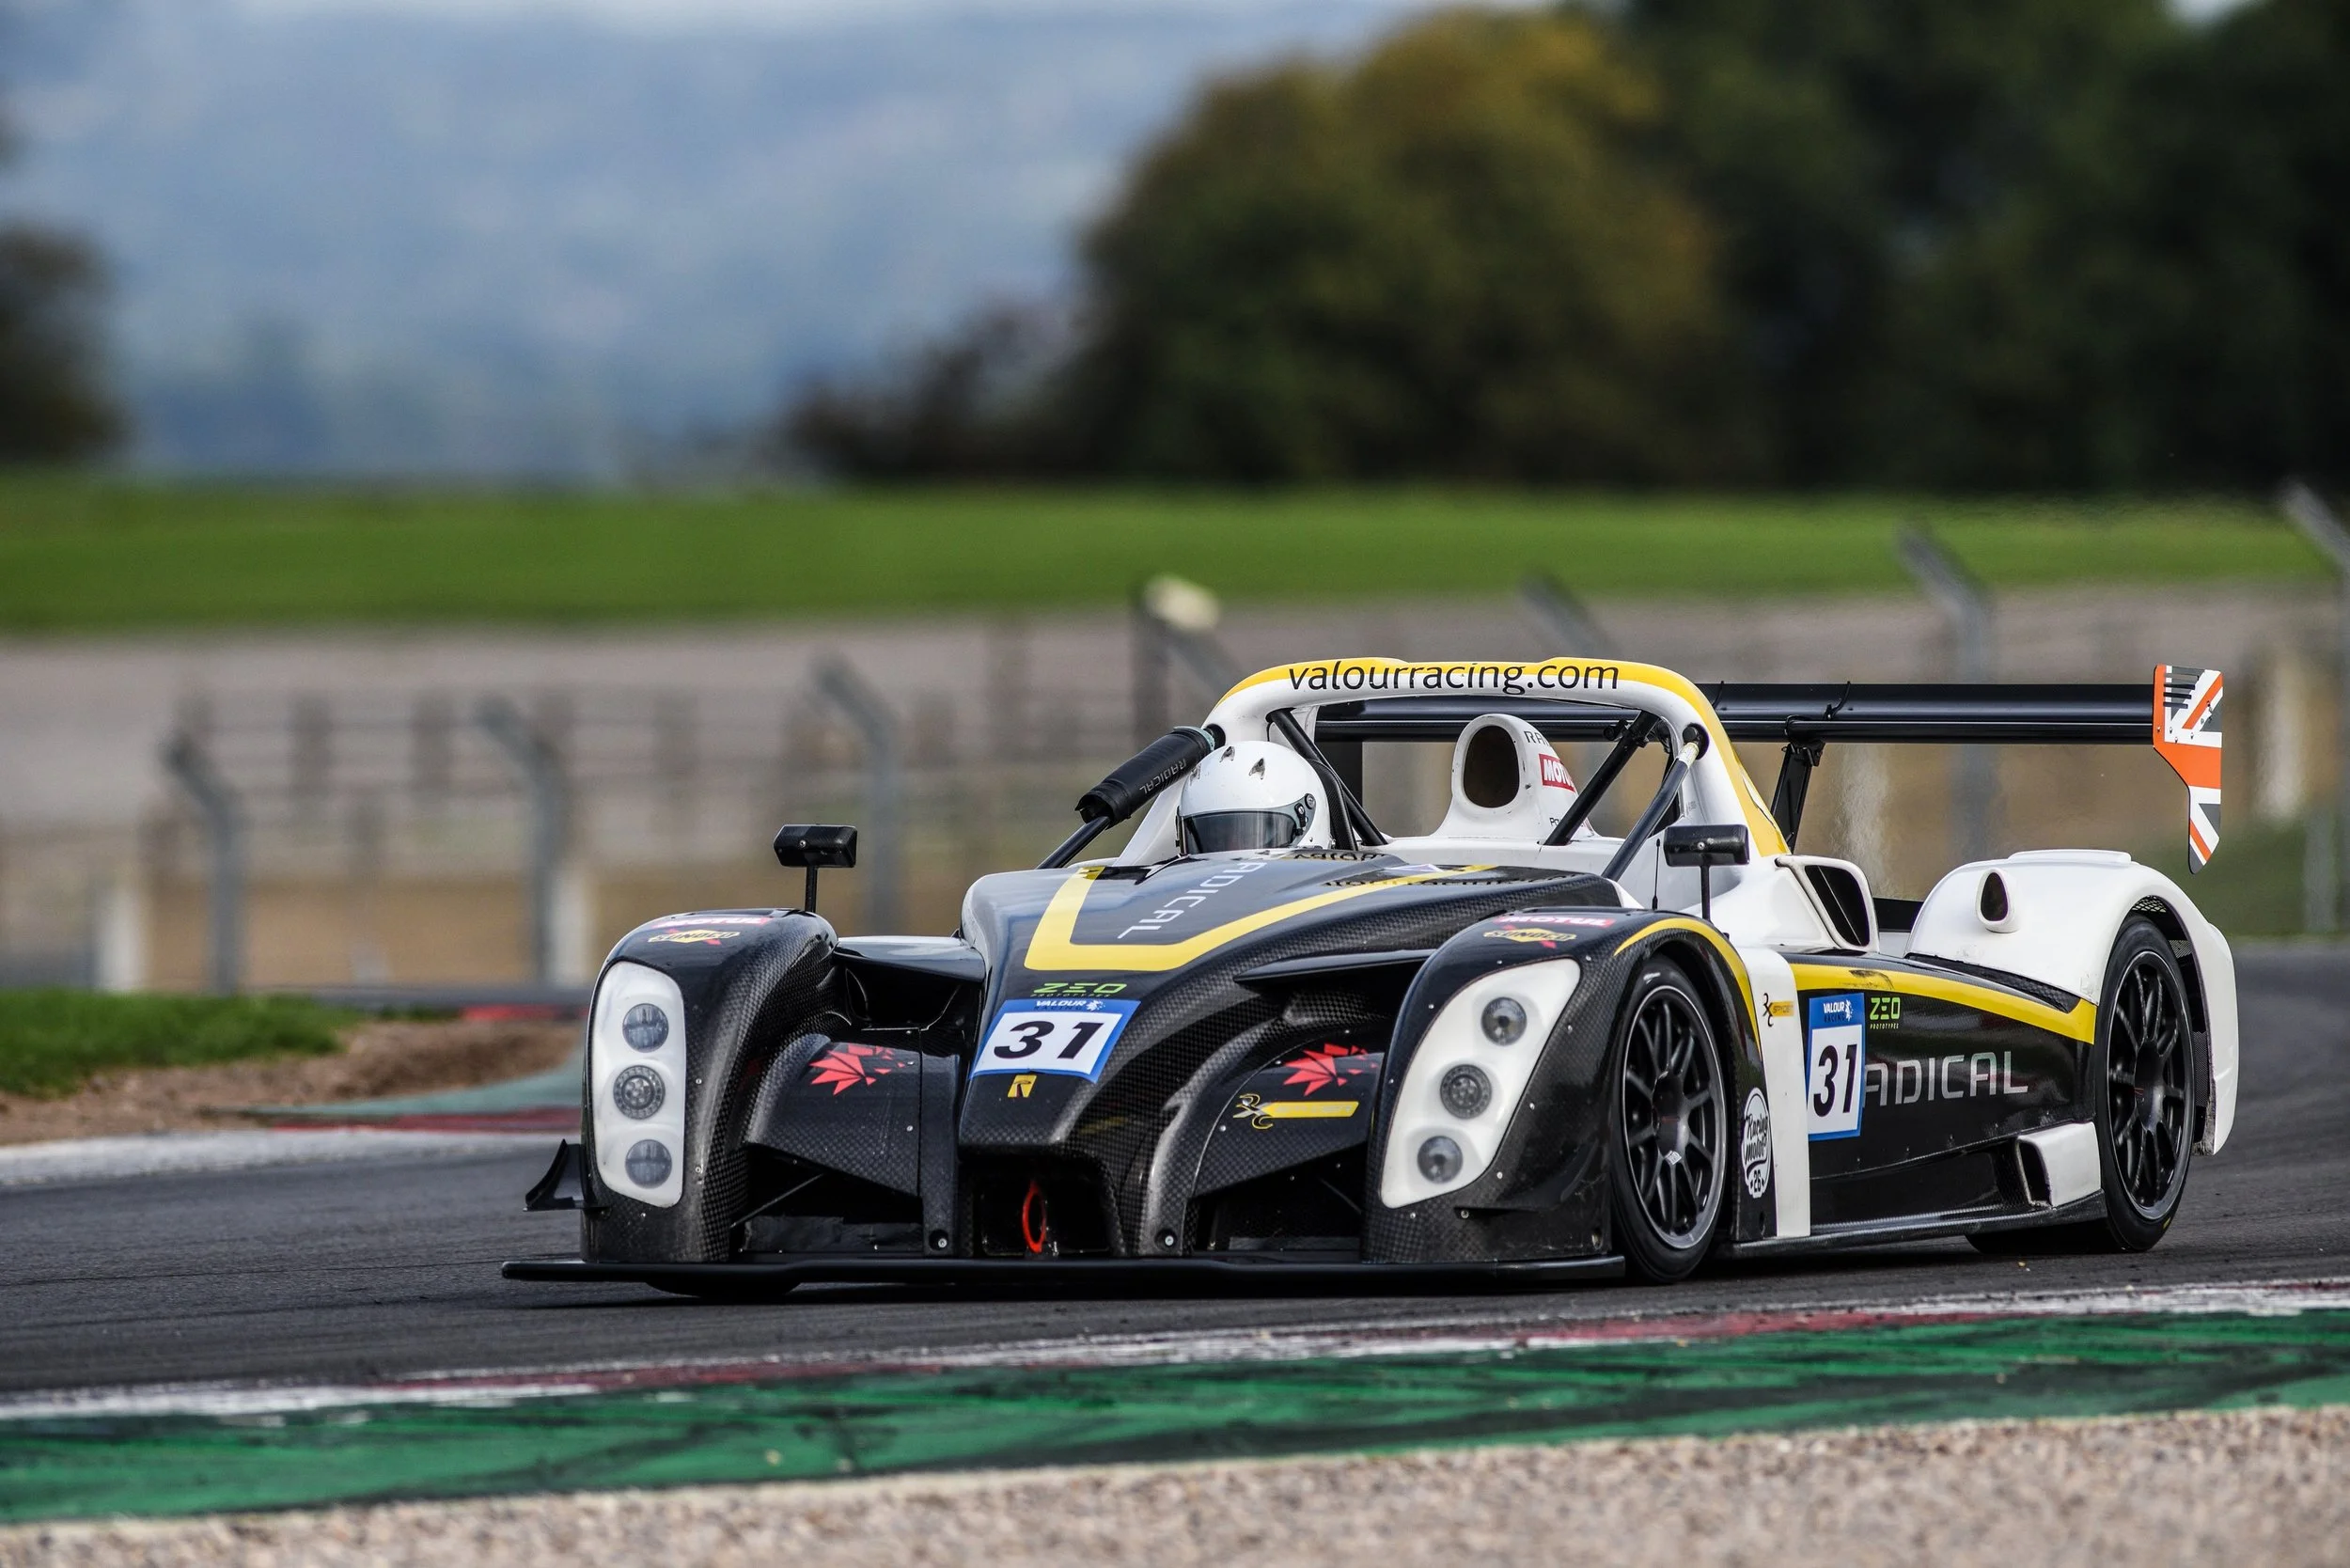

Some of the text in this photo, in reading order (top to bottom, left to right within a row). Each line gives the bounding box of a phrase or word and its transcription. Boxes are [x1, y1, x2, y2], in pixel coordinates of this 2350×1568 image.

[1289, 660, 1620, 696] valourracing.com
[1139, 759, 1187, 794] RADICAL
[1033, 982, 1127, 994] ZEO
[1823, 1000, 1845, 1014] VALOUR
[1870, 996, 1901, 1021] ZEO
[994, 1020, 1104, 1059] 31
[1813, 1043, 1858, 1118] 31
